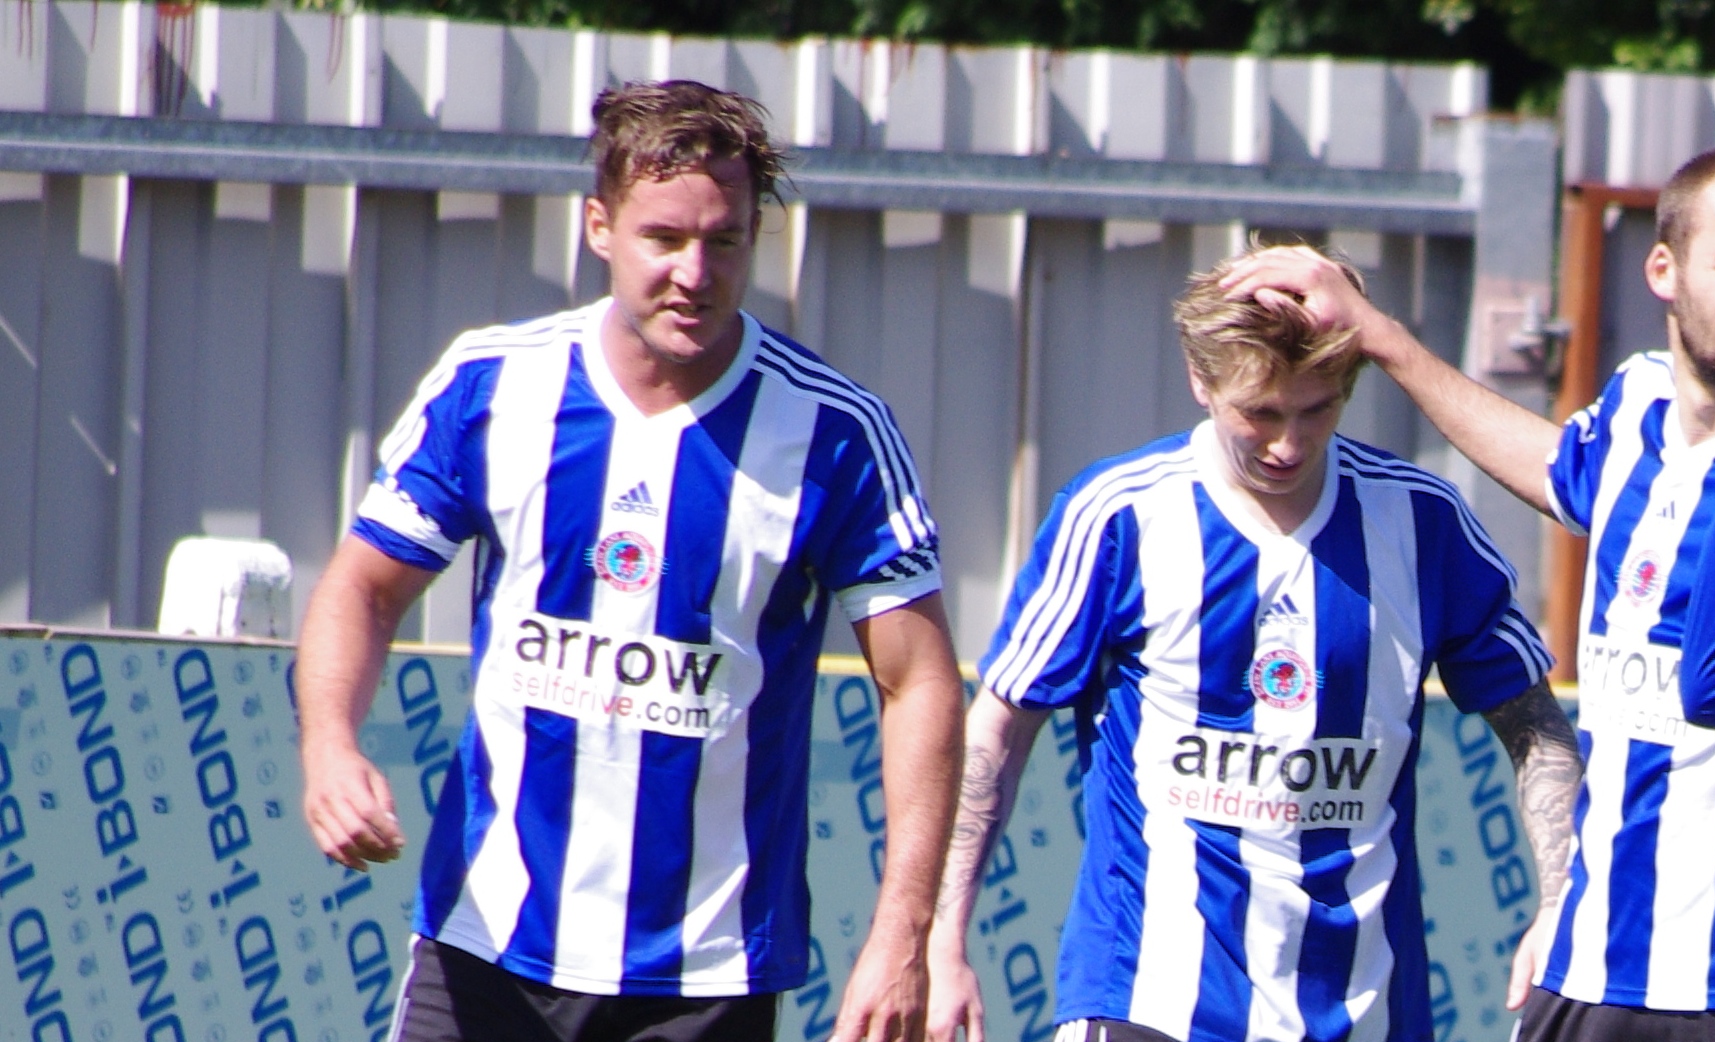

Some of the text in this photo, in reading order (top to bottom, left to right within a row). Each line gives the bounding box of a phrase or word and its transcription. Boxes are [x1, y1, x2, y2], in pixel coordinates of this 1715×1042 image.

[515, 618, 724, 696] arrow
[512, 671, 710, 729] selfdrive.com
[1171, 734, 1379, 793] arrow
[1167, 785, 1364, 824] selfdrive.com
